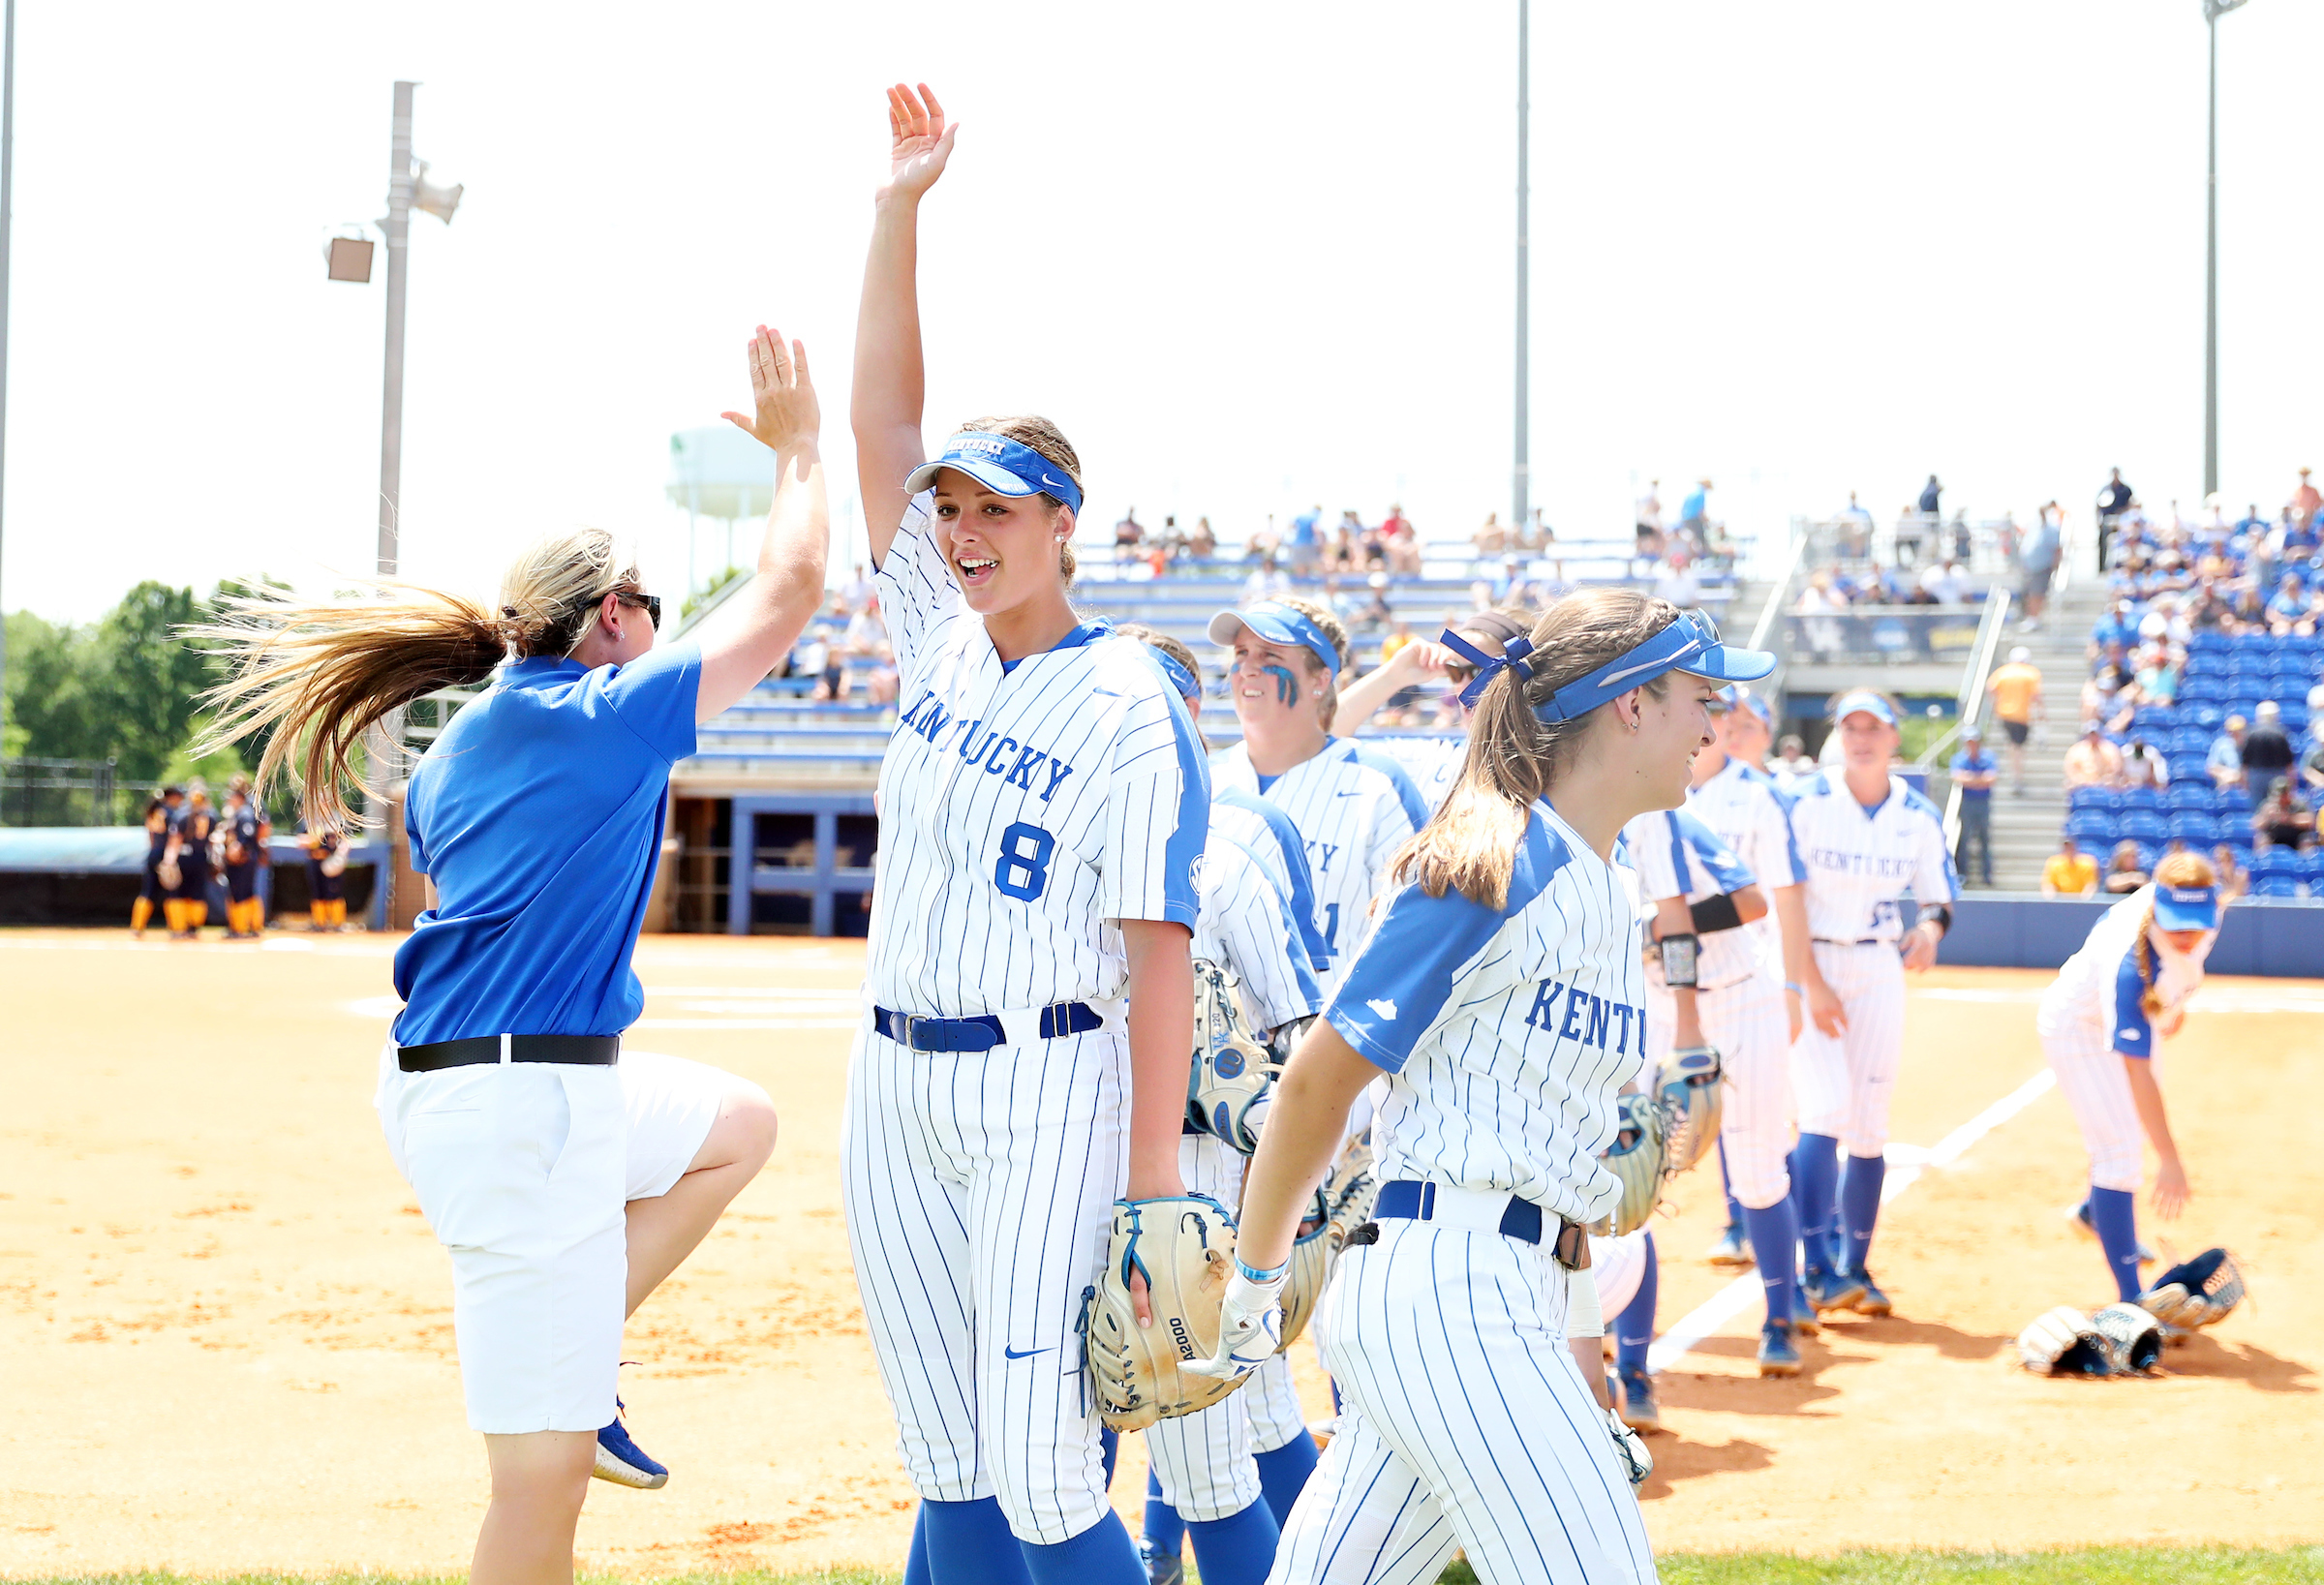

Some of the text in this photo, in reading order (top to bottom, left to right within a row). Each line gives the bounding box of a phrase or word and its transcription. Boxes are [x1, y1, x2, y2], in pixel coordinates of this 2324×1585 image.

[901, 690, 1074, 803] KNTUCKY
[994, 821, 1055, 903] 8
[1169, 1317, 1197, 1360] A2000
